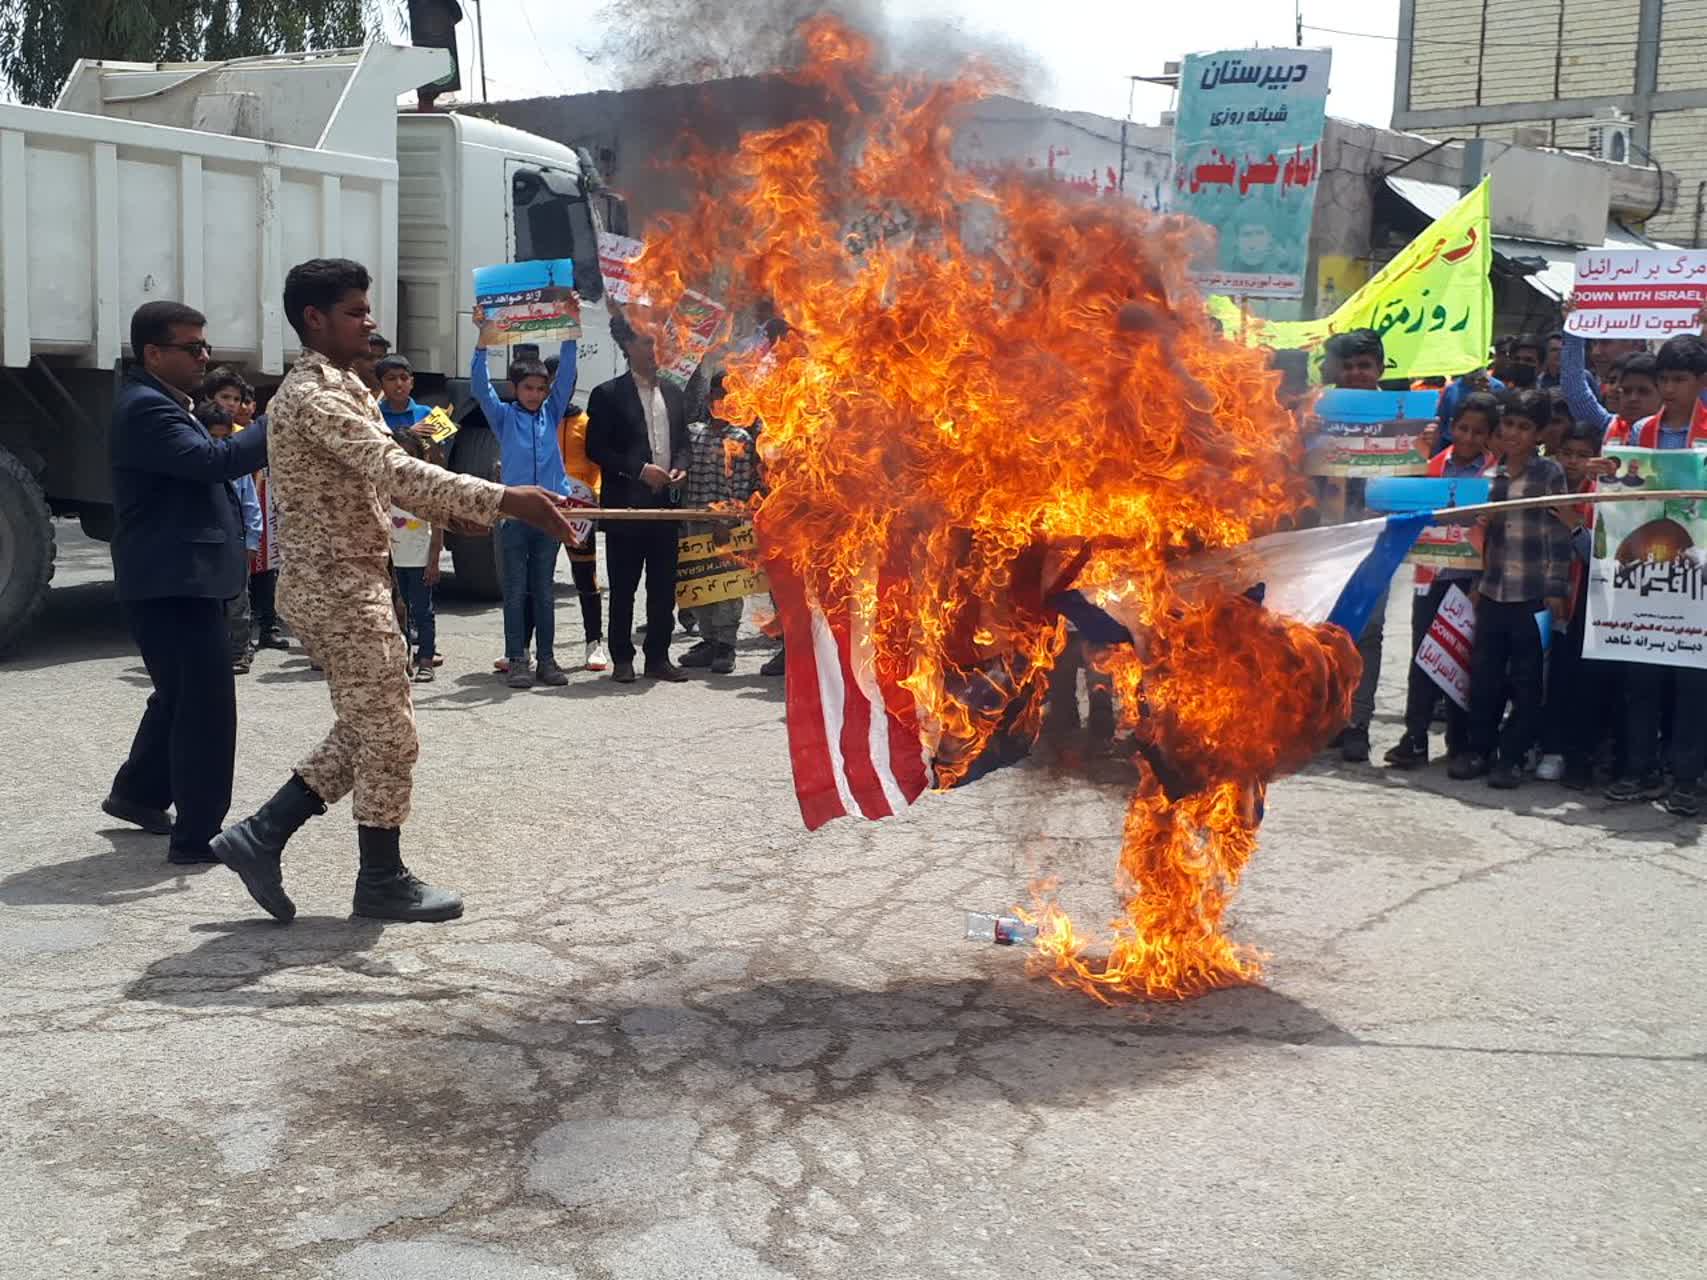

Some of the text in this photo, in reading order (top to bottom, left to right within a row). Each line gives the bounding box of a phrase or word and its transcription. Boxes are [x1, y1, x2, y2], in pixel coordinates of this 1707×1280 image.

[1199, 60, 1308, 92] دبیرستان
[1209, 104, 1288, 127] شبانه روزی
[1578, 258, 1639, 281] اسرائیل
[1667, 256, 1707, 279] مرگ
[495, 293, 523, 304] خواهد
[1575, 290, 1704, 302] DOWN WITH ISRAEL
[1404, 289, 1470, 334] روز
[1568, 313, 1700, 335] الموت لاسرائیل
[1605, 634, 1703, 655] دبستان پسرانه شاهد
